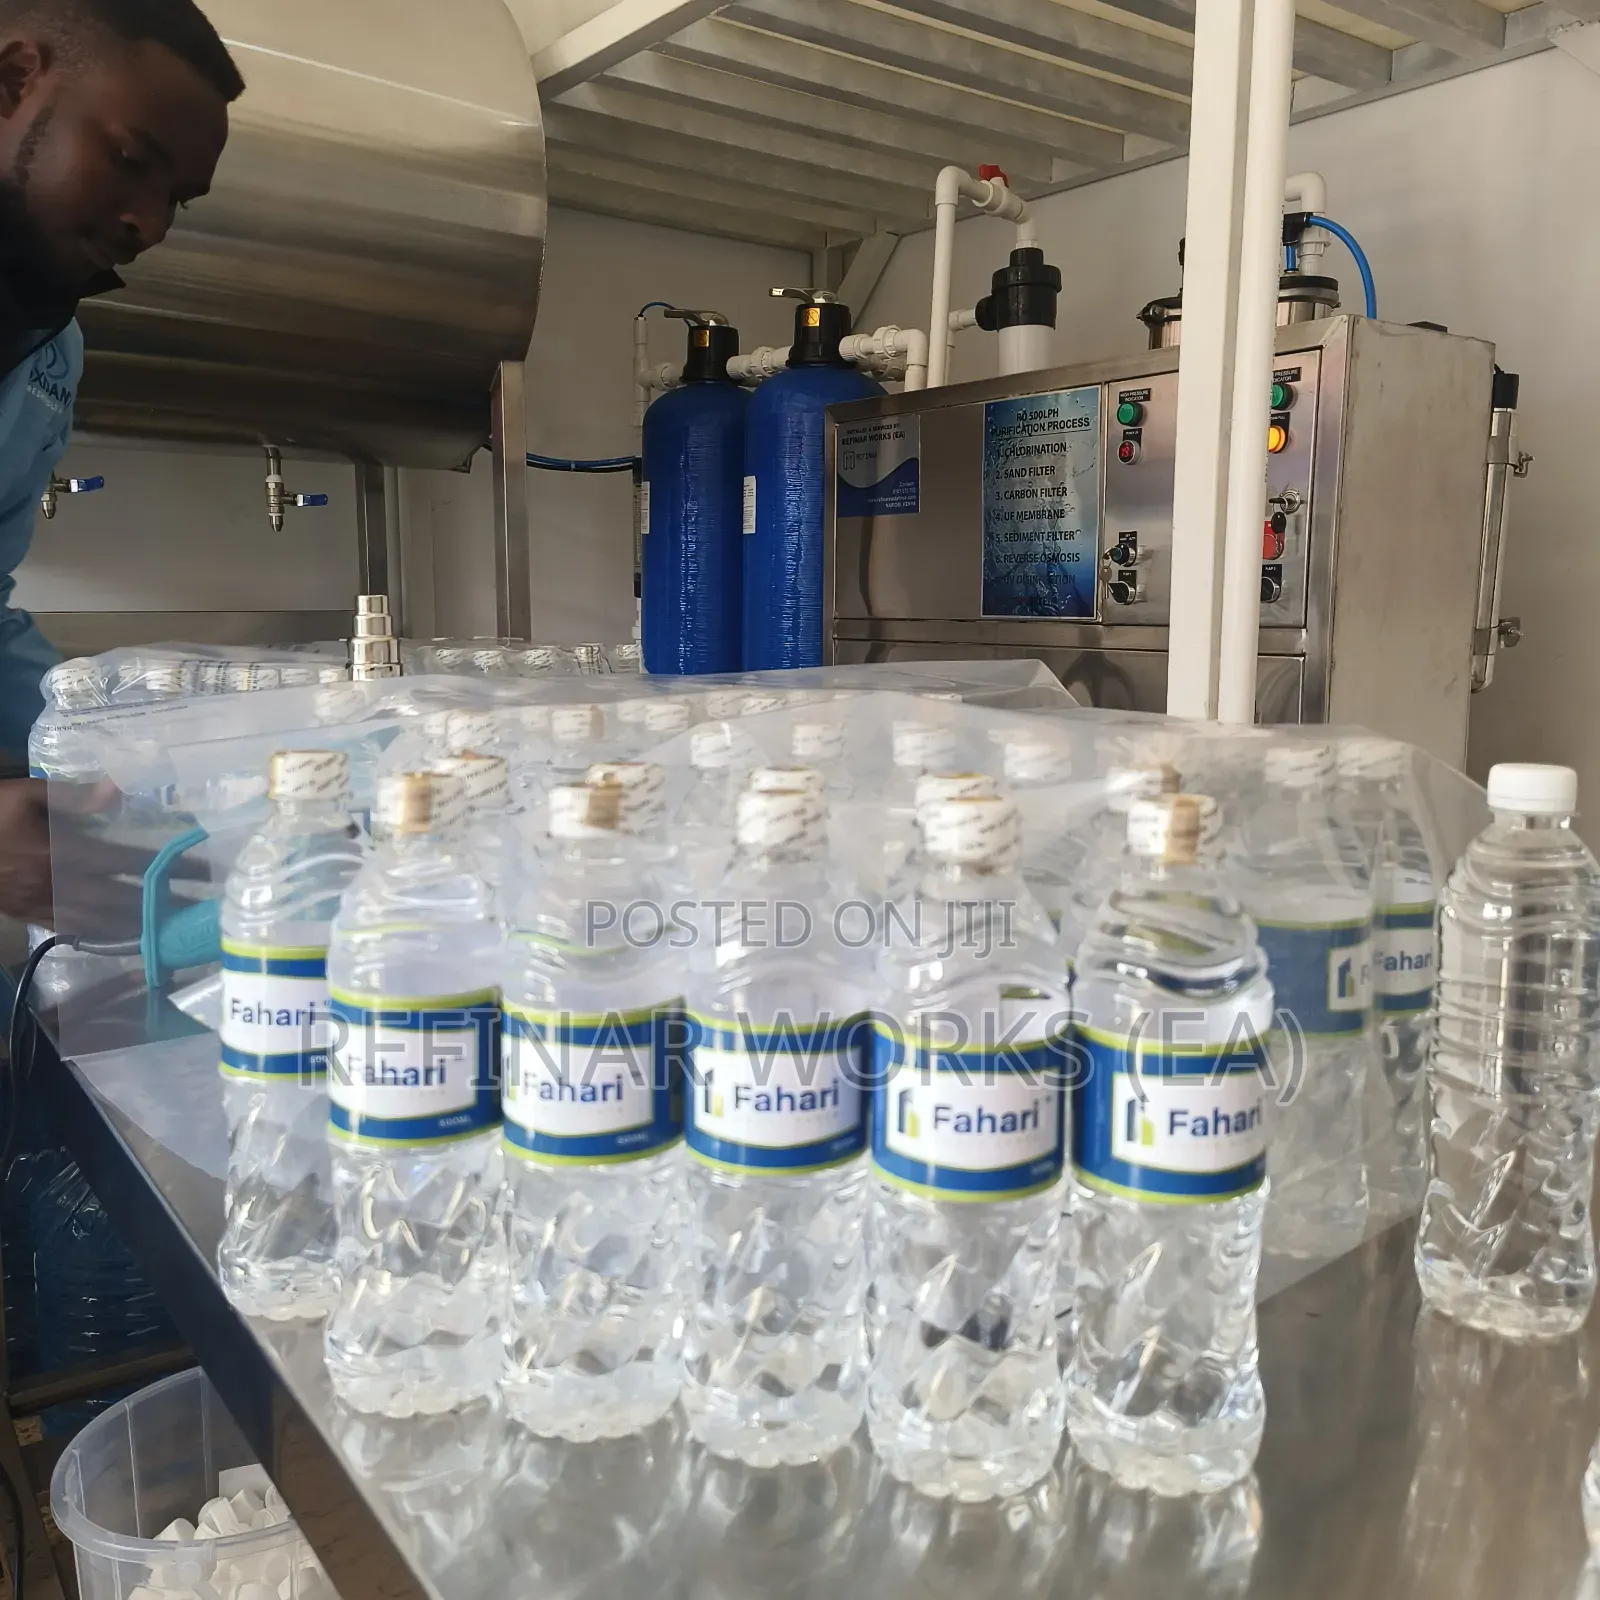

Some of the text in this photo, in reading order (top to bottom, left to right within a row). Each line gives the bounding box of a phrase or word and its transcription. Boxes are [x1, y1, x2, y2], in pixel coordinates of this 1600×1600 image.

[1016, 411, 1028, 422] RO
[991, 417, 1090, 436] PURIFICATION PROCESS
[868, 432, 892, 442] WORKS
[892, 430, 907, 440] (EA)
[1004, 442, 1067, 458] CHLORINATION
[996, 465, 1056, 480] 2. SAND FILTER
[996, 486, 1068, 500] 3. CARBON FILTER
[1004, 511, 1015, 521] UF
[1016, 509, 1066, 521] MEMBRANE
[1004, 531, 1046, 543] SEDIMENT
[1047, 530, 1075, 541] FILTER
[1003, 553, 1039, 564] REVERSE
[1041, 552, 1080, 564] OSMOSIS
[230, 998, 316, 1027] Fahari
[347, 1054, 447, 1087] Fahari
[522, 1070, 625, 1103] Fahari
[733, 1078, 840, 1113] Fahari
[932, 1099, 1040, 1135] Fahari
[1168, 1098, 1262, 1138] Fahari
